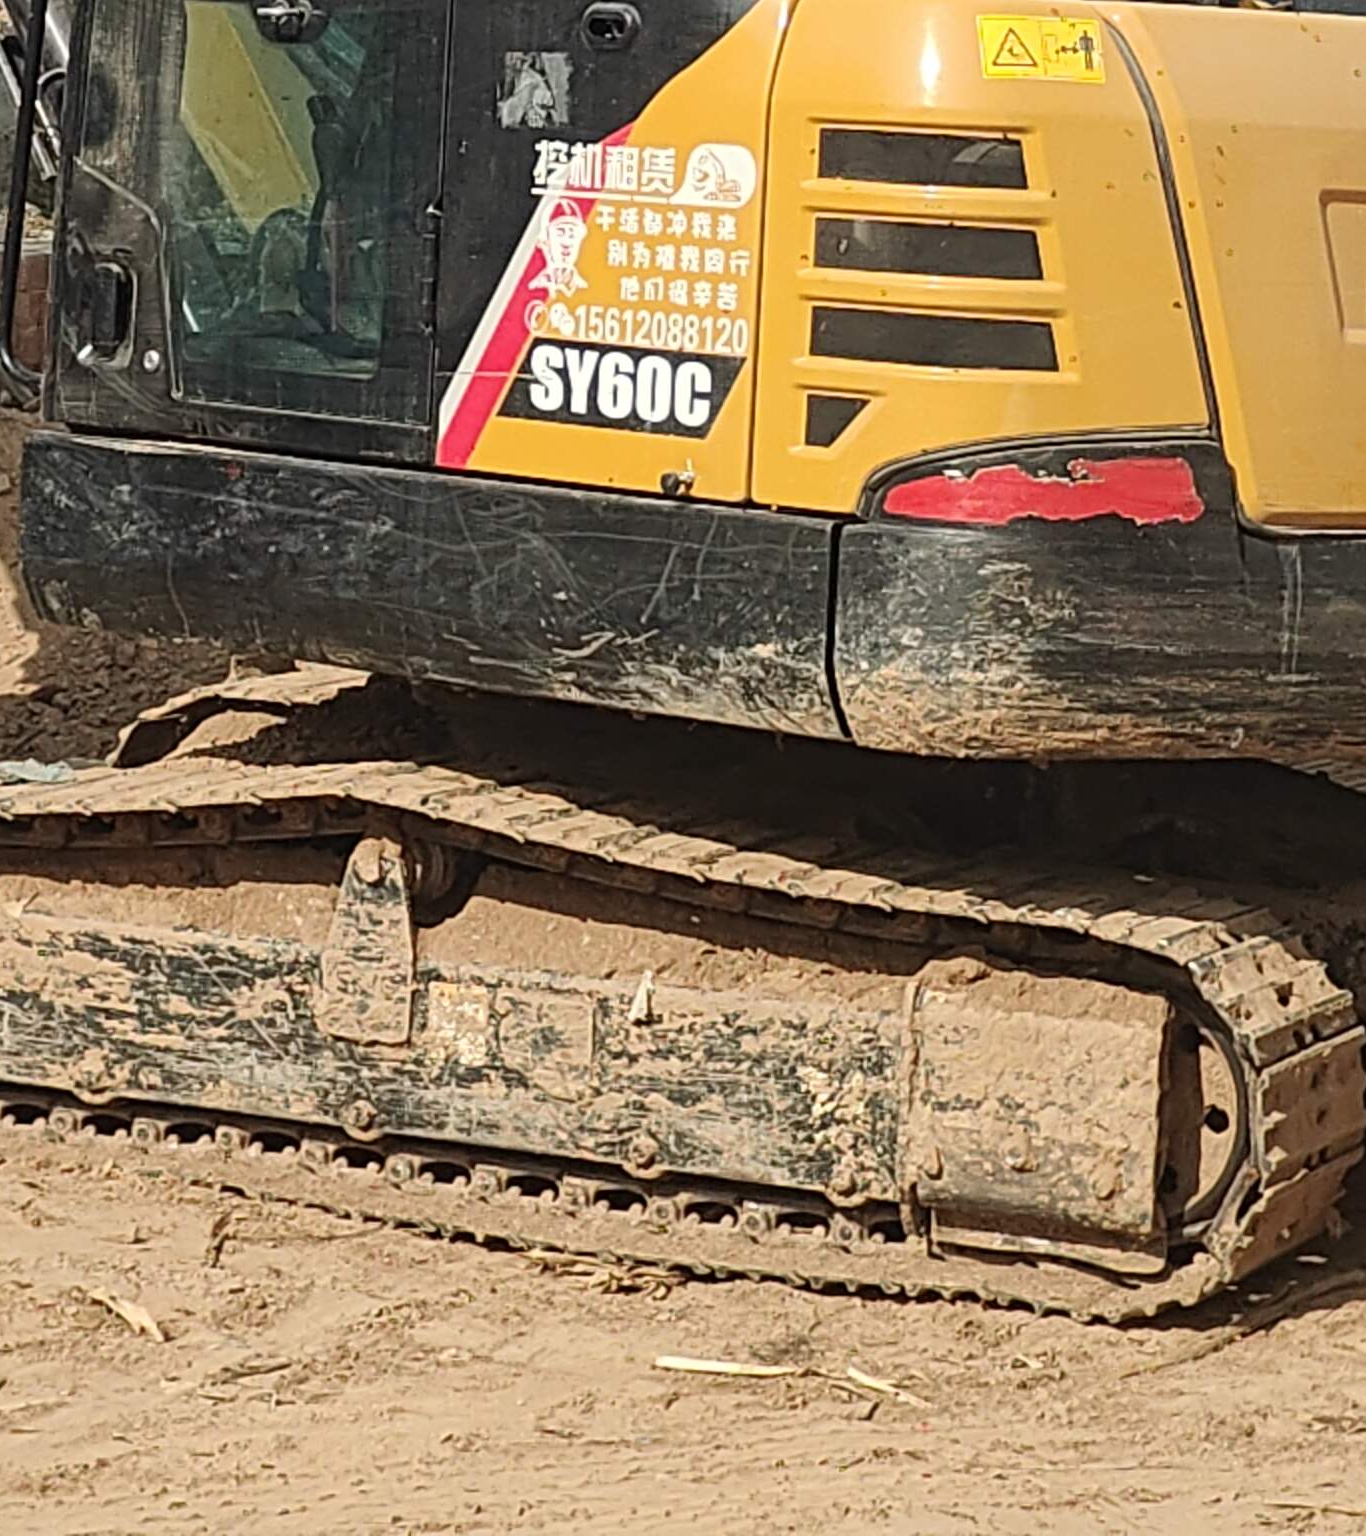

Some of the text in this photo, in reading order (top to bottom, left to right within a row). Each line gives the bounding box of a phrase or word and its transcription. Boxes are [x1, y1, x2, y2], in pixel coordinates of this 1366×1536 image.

[533, 140, 676, 194] 挖机租赁
[595, 205, 737, 242] 干活都冲我来
[576, 304, 748, 354] 15612088120
[530, 344, 712, 427] SY60C
